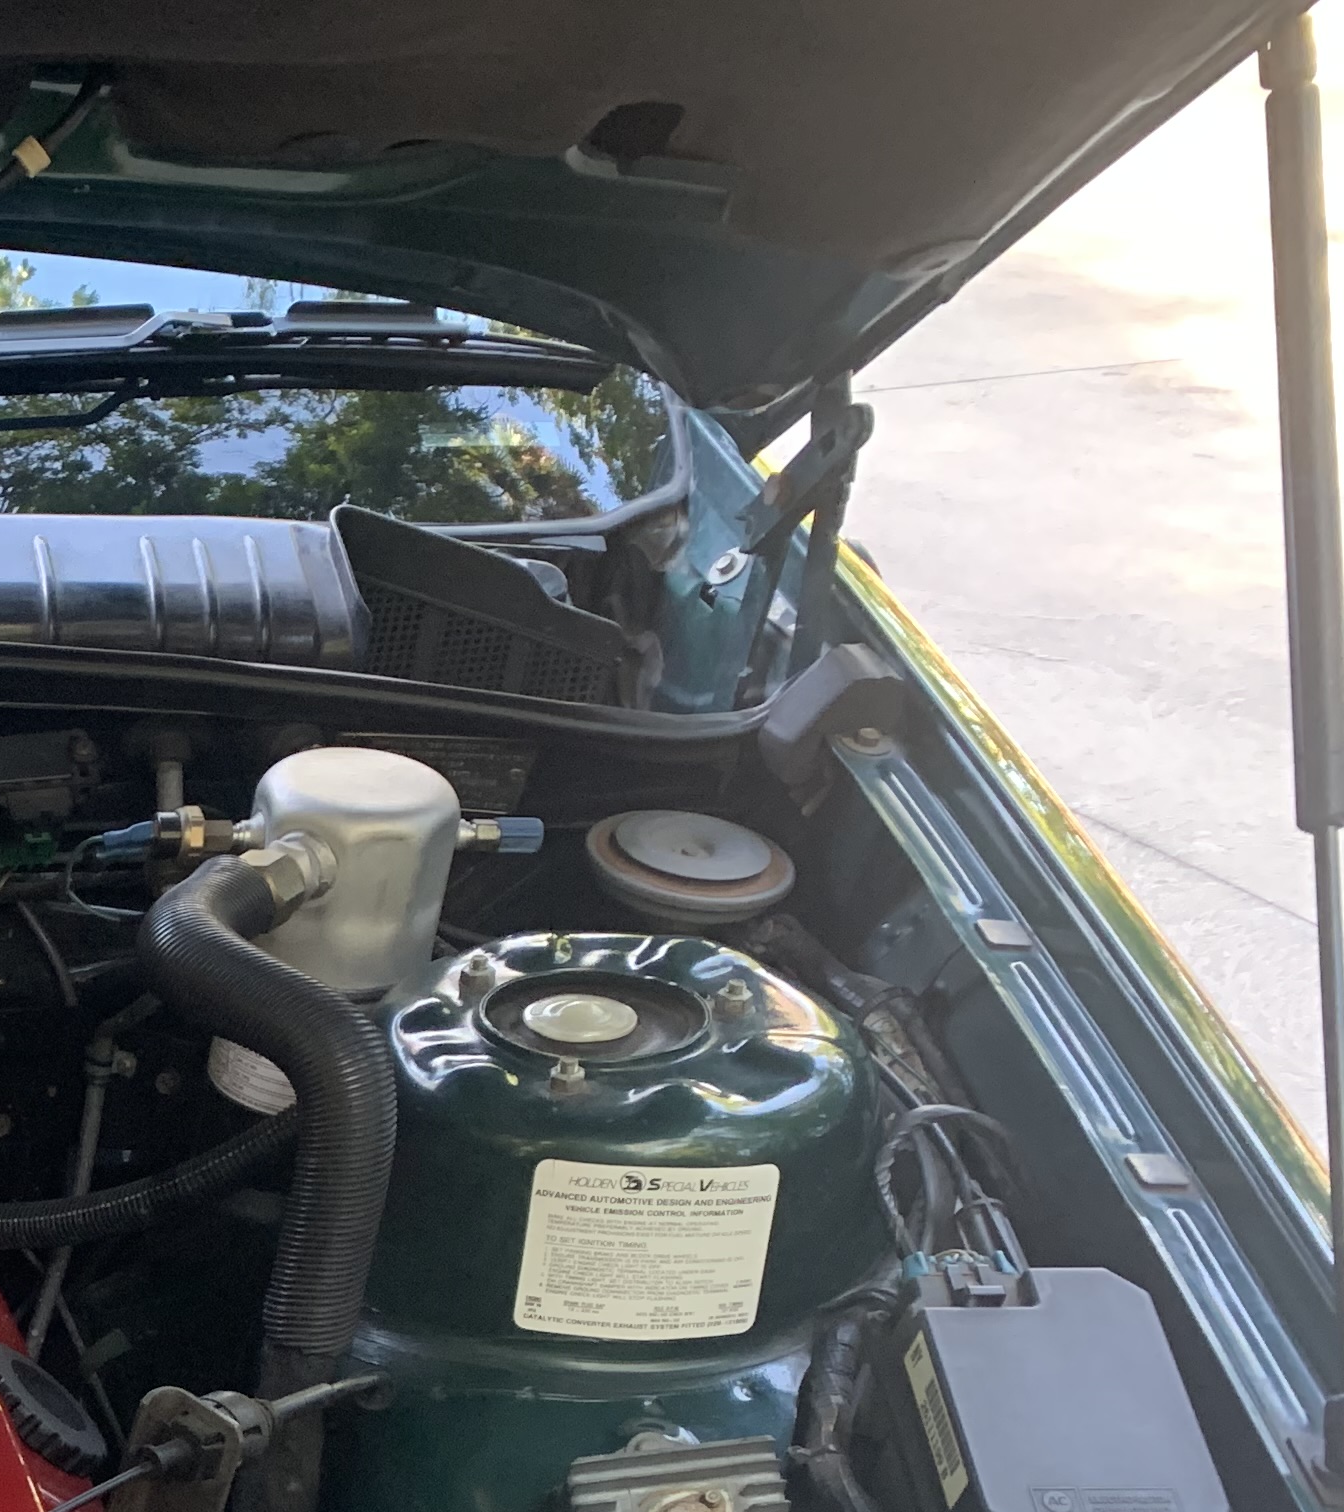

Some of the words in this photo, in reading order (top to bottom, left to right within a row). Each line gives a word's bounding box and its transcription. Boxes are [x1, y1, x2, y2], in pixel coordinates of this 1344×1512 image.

[568, 1176, 617, 1189] HOLDEN
[536, 1189, 587, 1201] ADVANCED
[590, 1196, 652, 1205] AUTOMOTIVE
[657, 1198, 691, 1206] DESIGN
[565, 1205, 599, 1213] VEHICLE
[604, 1208, 643, 1216] EMISSION
